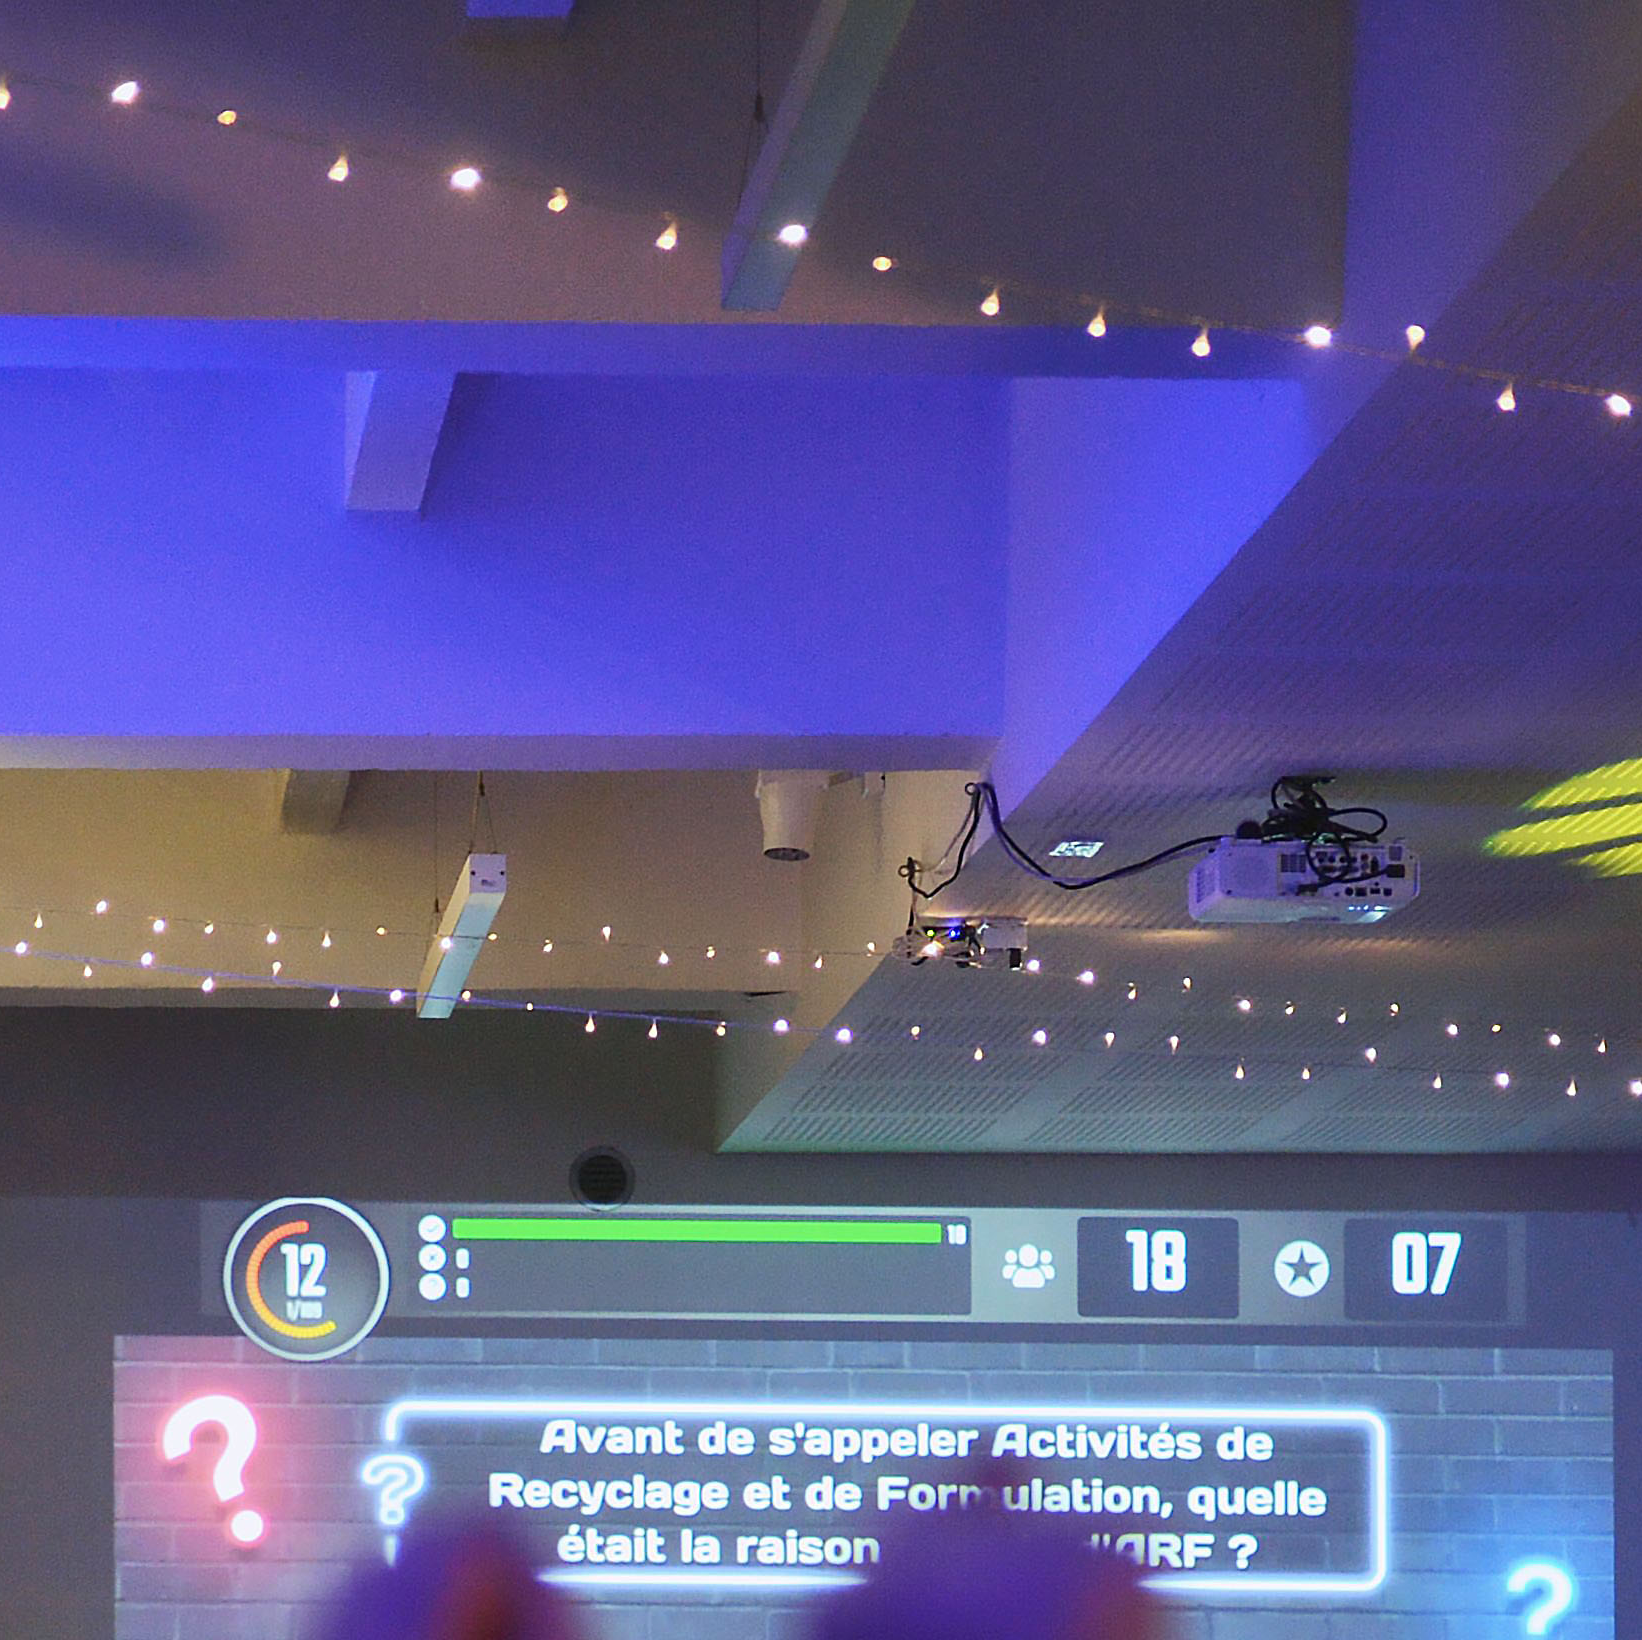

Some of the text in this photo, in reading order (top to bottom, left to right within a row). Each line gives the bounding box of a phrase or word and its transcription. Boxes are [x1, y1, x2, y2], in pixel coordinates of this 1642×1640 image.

[279, 1242, 327, 1298] 12
[1125, 1229, 1187, 1293] 18
[1391, 1231, 1462, 1296] 07
[538, 1418, 1275, 1464] Avant de s'appeler Activités de
[488, 1472, 731, 1517] Recyclage
[741, 1474, 793, 1511] et
[803, 1475, 864, 1512] de
[1186, 1479, 1329, 1523] quelle
[556, 1523, 668, 1564] était
[679, 1527, 722, 1564] la
[735, 1528, 881, 1565] raison
[1226, 1533, 1261, 1570] ?
